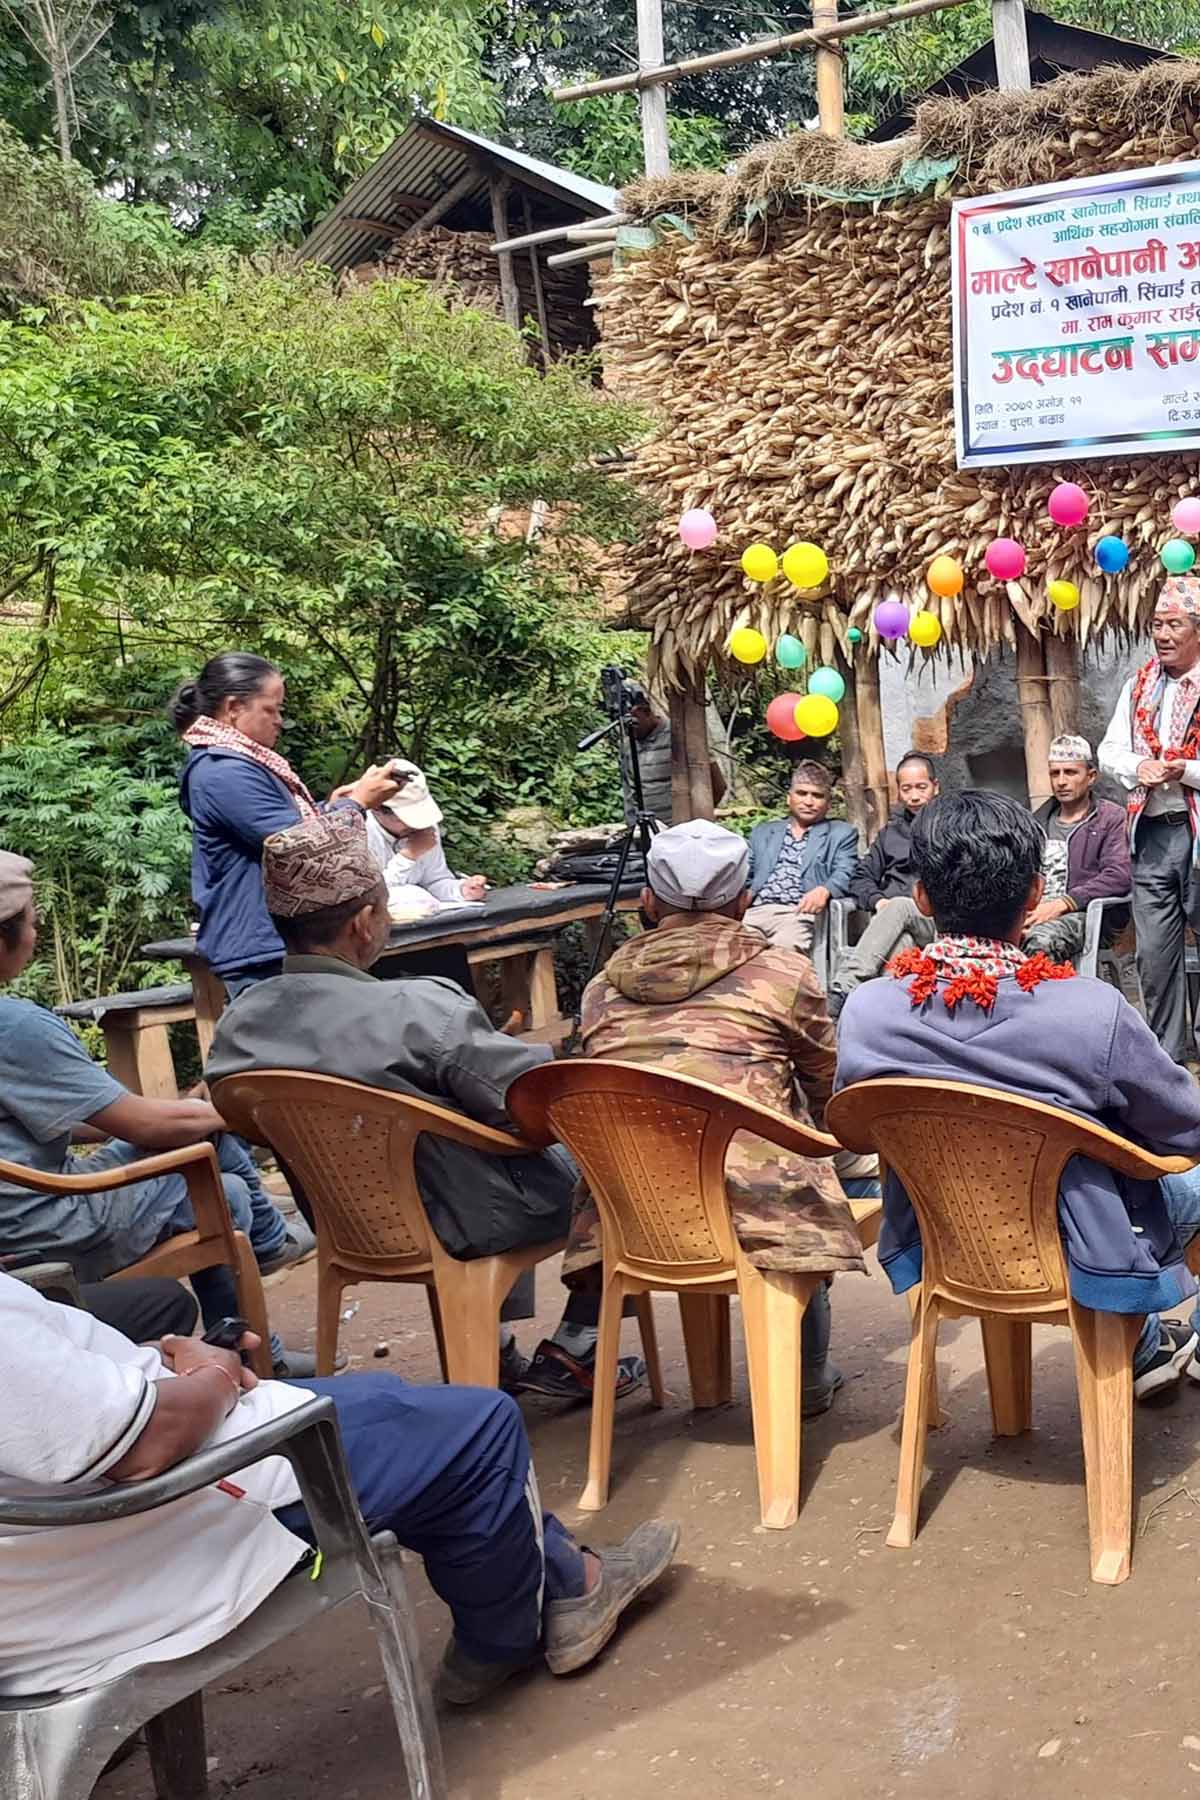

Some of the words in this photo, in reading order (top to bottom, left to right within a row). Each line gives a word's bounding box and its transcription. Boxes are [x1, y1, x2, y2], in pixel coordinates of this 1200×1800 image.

[997, 215, 1023, 234] प्रदेश
[1026, 209, 1066, 228] सरकार
[1176, 191, 1200, 207] तथा
[1052, 222, 1095, 244] आर्थिक
[1099, 217, 1159, 239] सहयोगमा
[971, 256, 1038, 296] माल्टे
[1044, 238, 1169, 288] खानेपानी
[991, 300, 1025, 321] प्रदेश
[1030, 299, 1046, 315] नं.
[1051, 298, 1060, 312] १
[1137, 278, 1185, 301] सिंचाई
[1087, 313, 1113, 333] राम
[1117, 309, 1164, 331] कुमार
